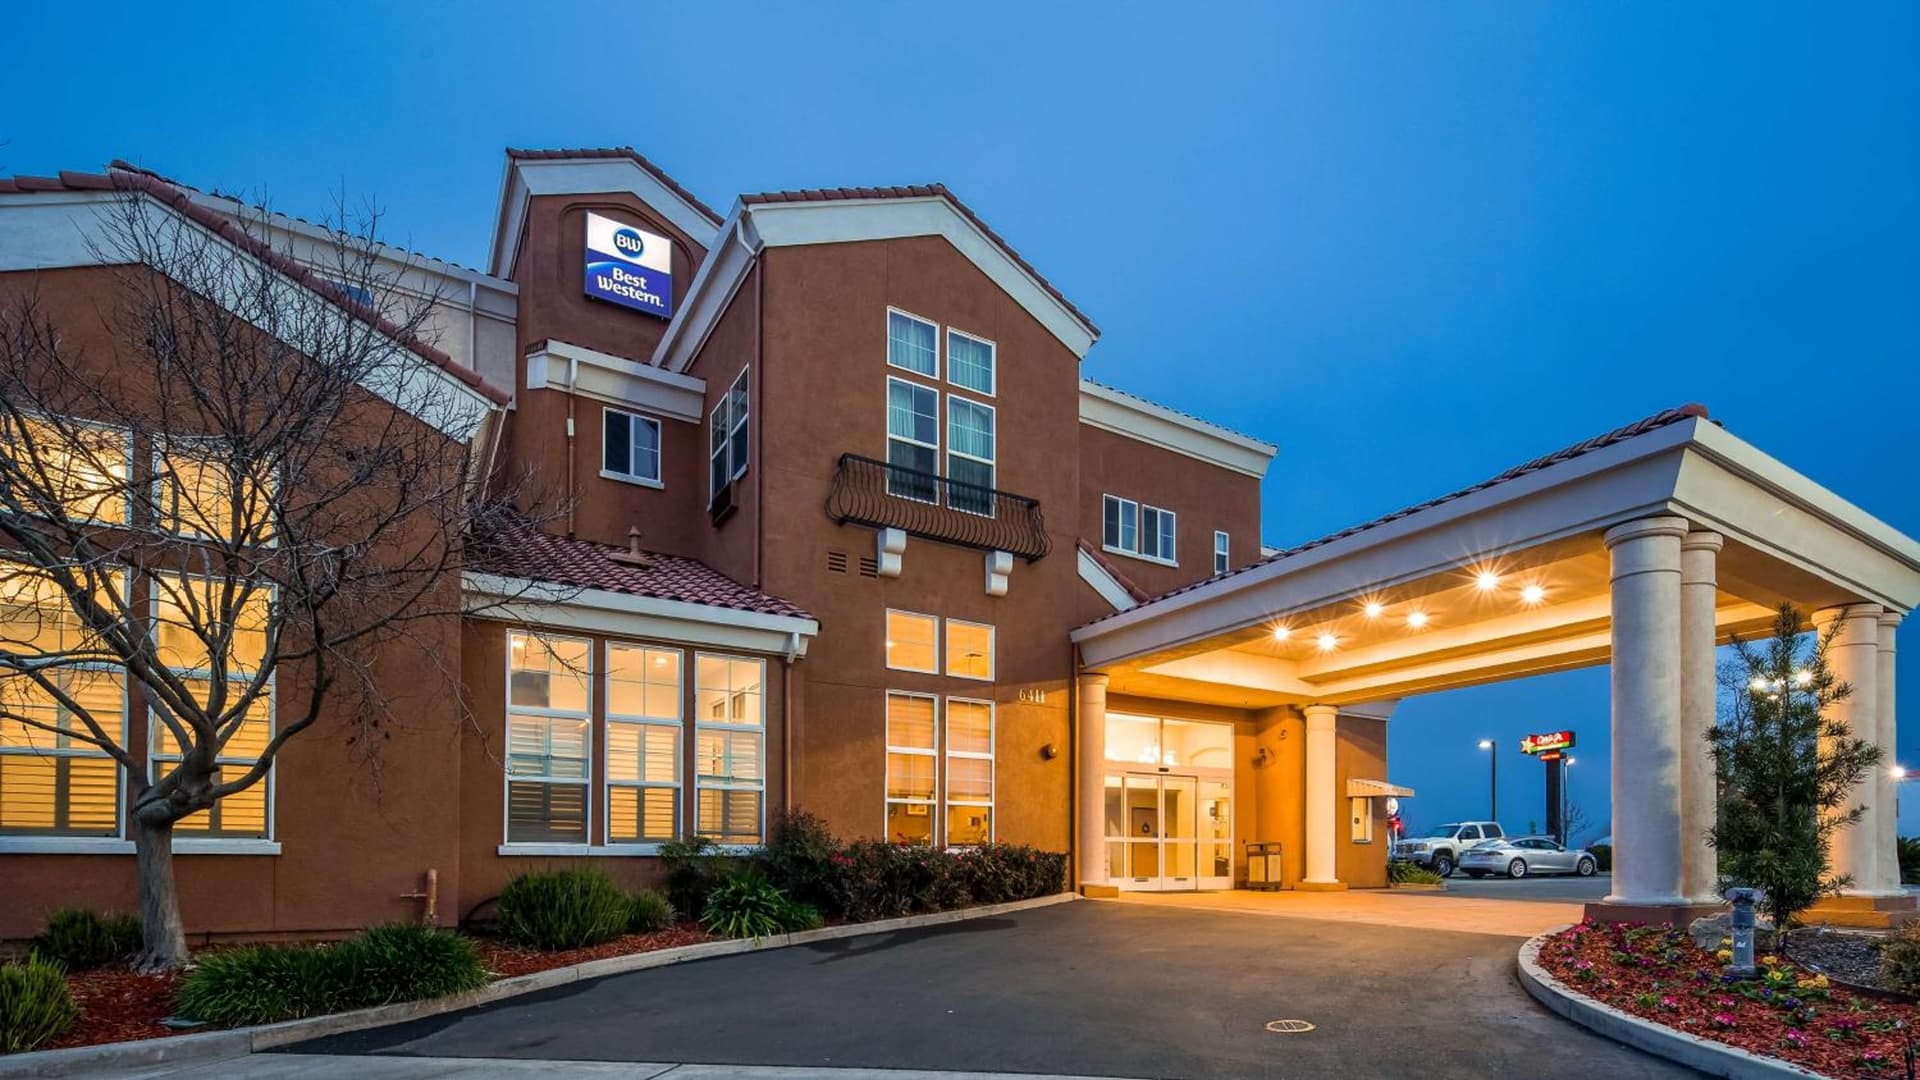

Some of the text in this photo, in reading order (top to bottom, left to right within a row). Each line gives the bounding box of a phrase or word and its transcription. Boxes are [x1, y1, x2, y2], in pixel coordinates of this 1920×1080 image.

[616, 233, 641, 252] BW
[612, 267, 647, 289] Best
[1019, 688, 1045, 704] 6411
